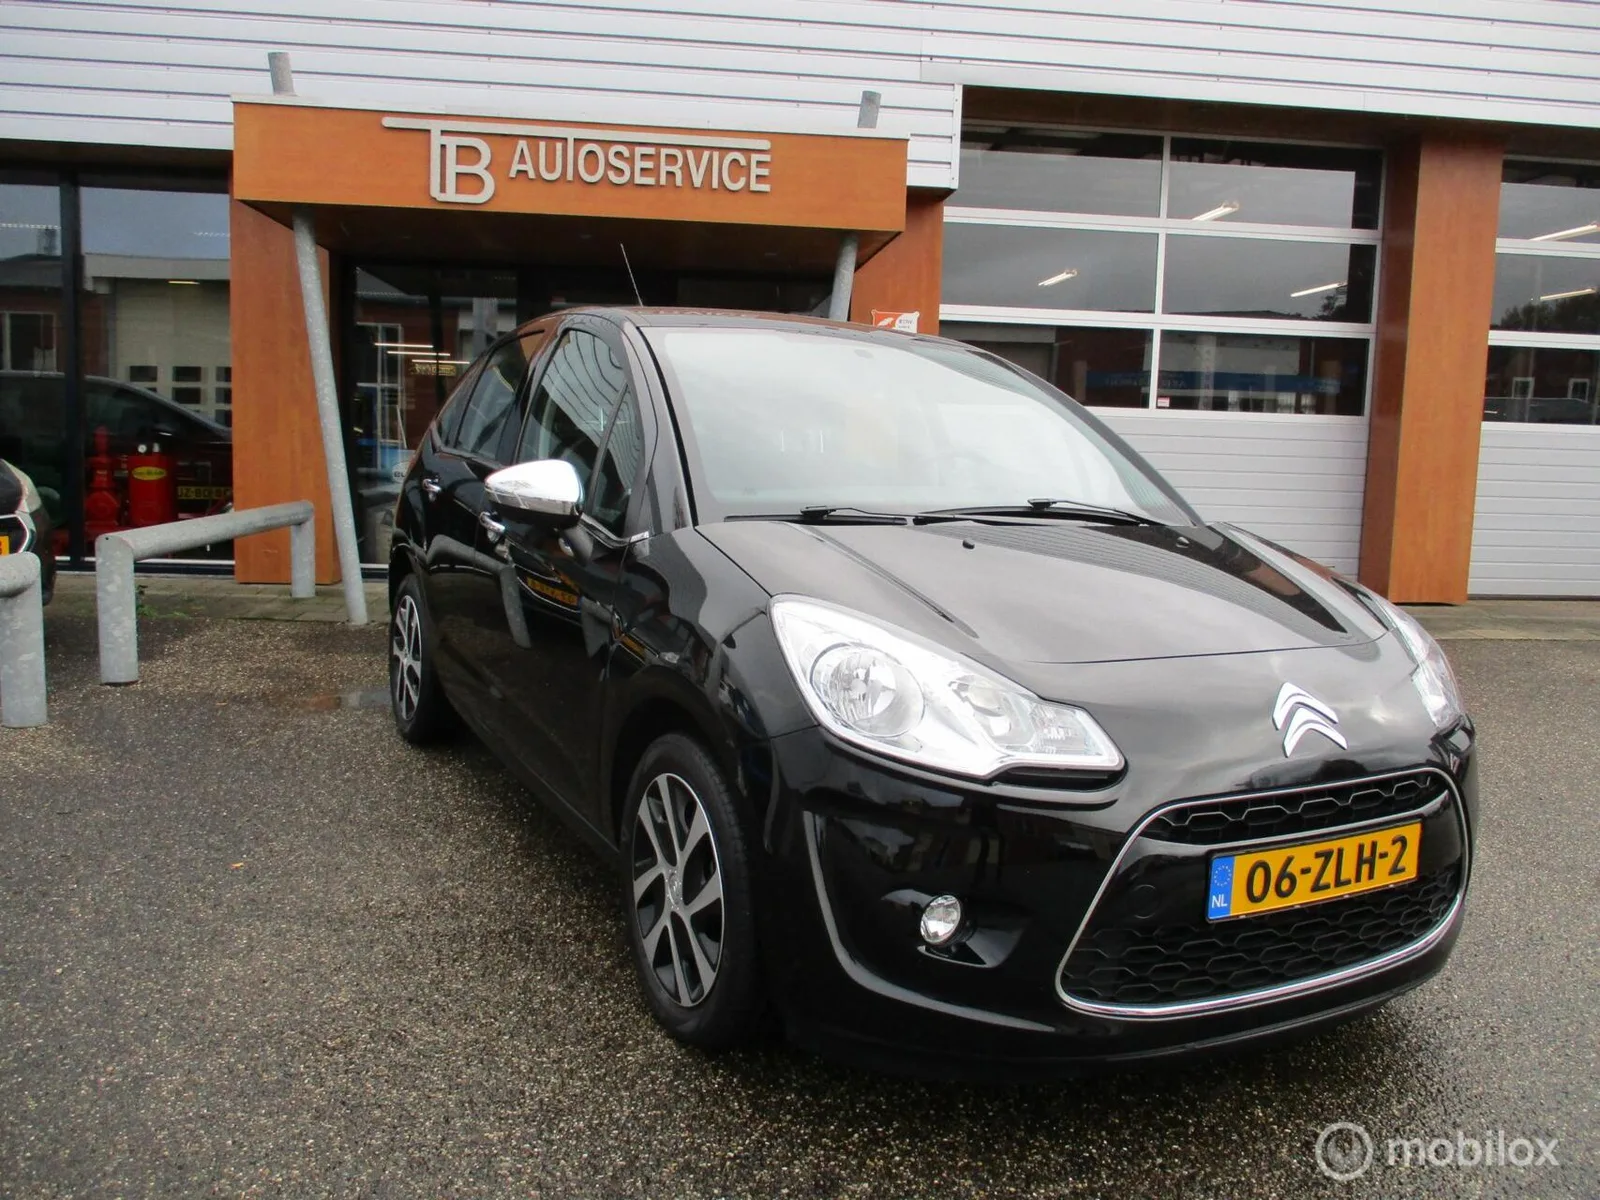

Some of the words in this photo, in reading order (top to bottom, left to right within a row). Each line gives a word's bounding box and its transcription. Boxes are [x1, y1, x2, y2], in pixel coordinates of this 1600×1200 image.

[508, 137, 771, 193] AUTOSERVICE
[1246, 835, 1408, 904] 06-ZLH-2
[1211, 894, 1228, 909] NL
